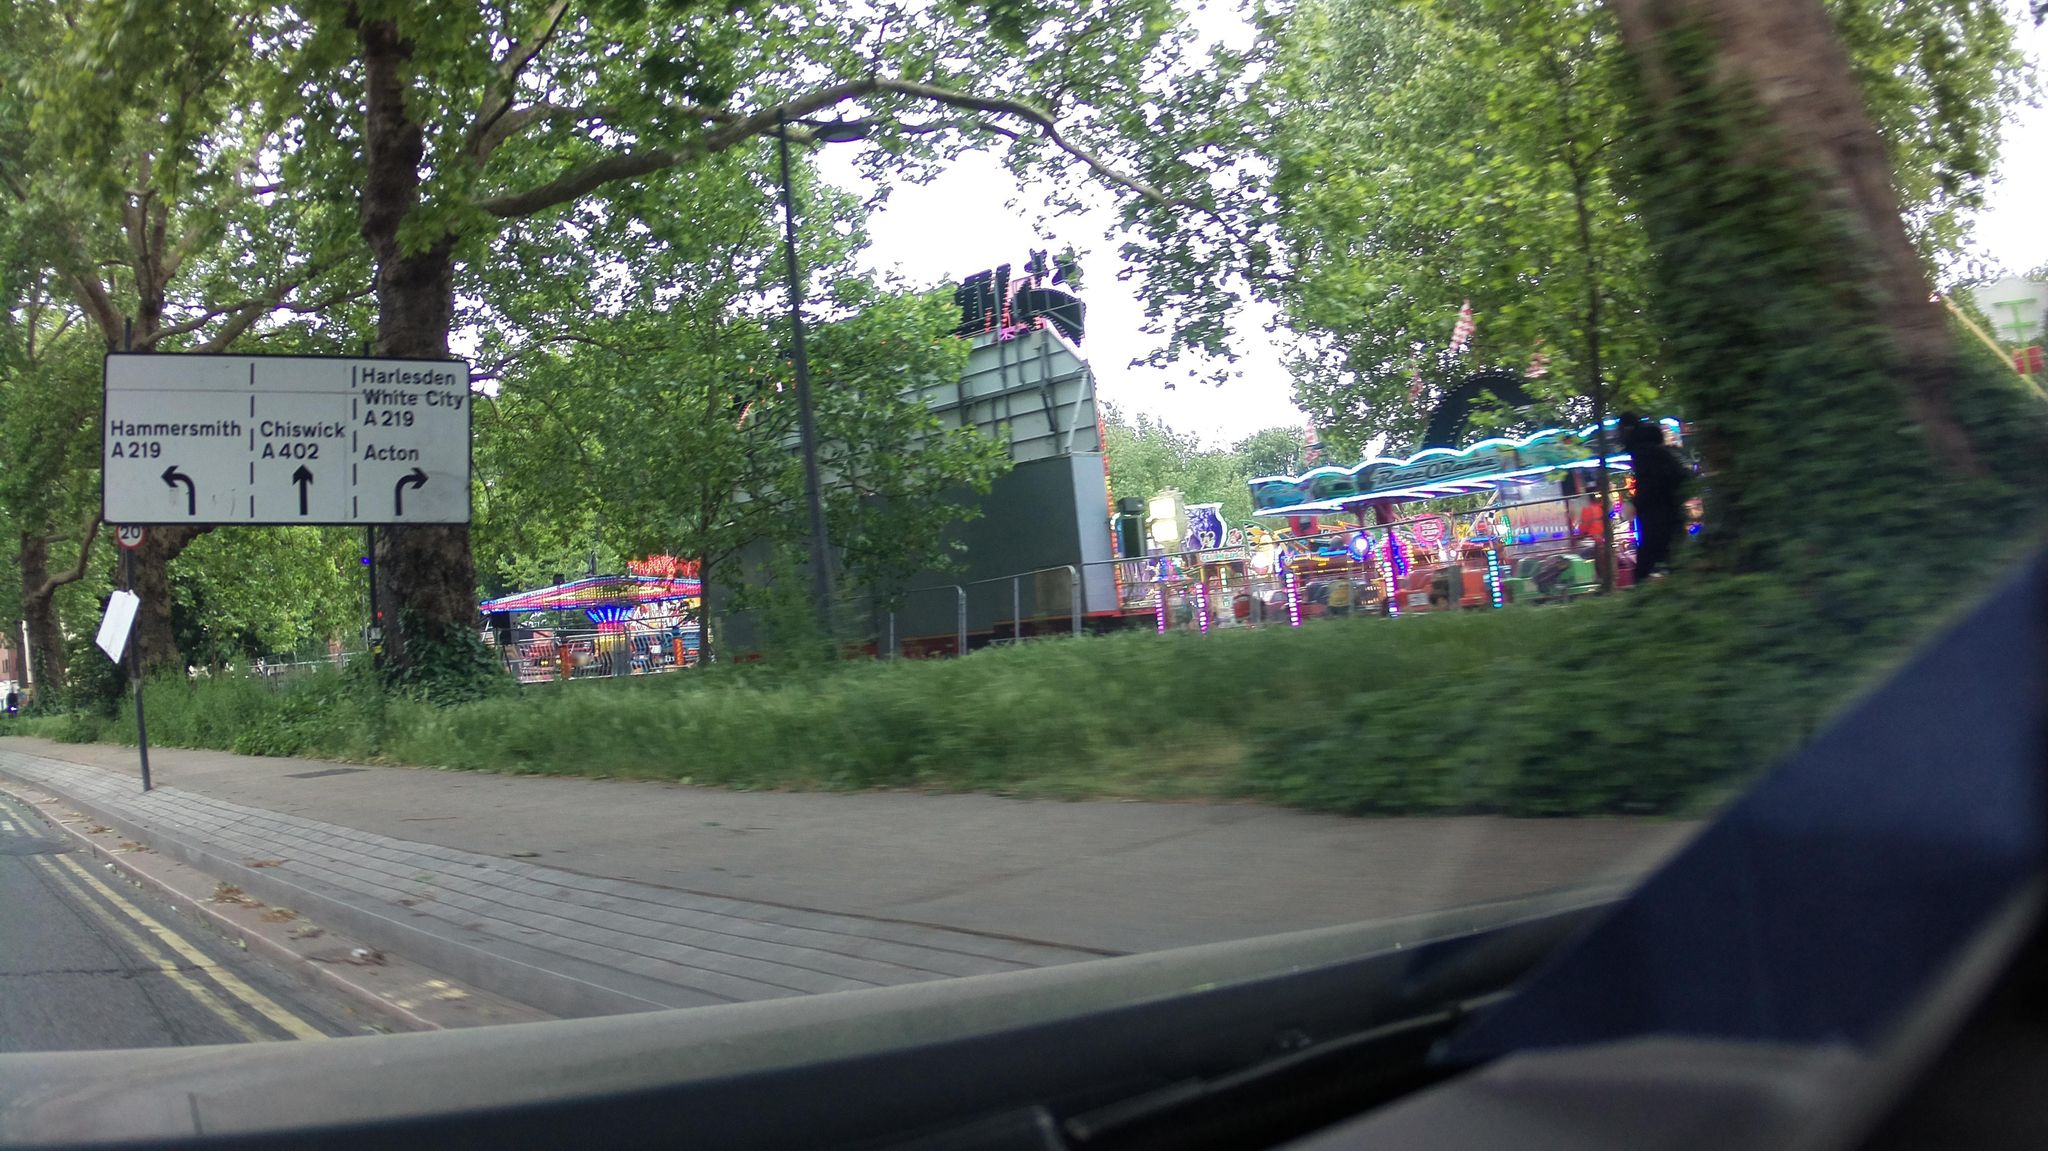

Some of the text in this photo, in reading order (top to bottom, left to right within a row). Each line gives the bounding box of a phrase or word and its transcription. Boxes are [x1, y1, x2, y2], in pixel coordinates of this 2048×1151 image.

[362, 367, 456, 386] Harlesden
[363, 389, 464, 410] White City
[110, 420, 242, 437] Hammersmith
[260, 421, 346, 438] Chiswick
[364, 445, 420, 461] Acton
[120, 526, 141, 540] 20
